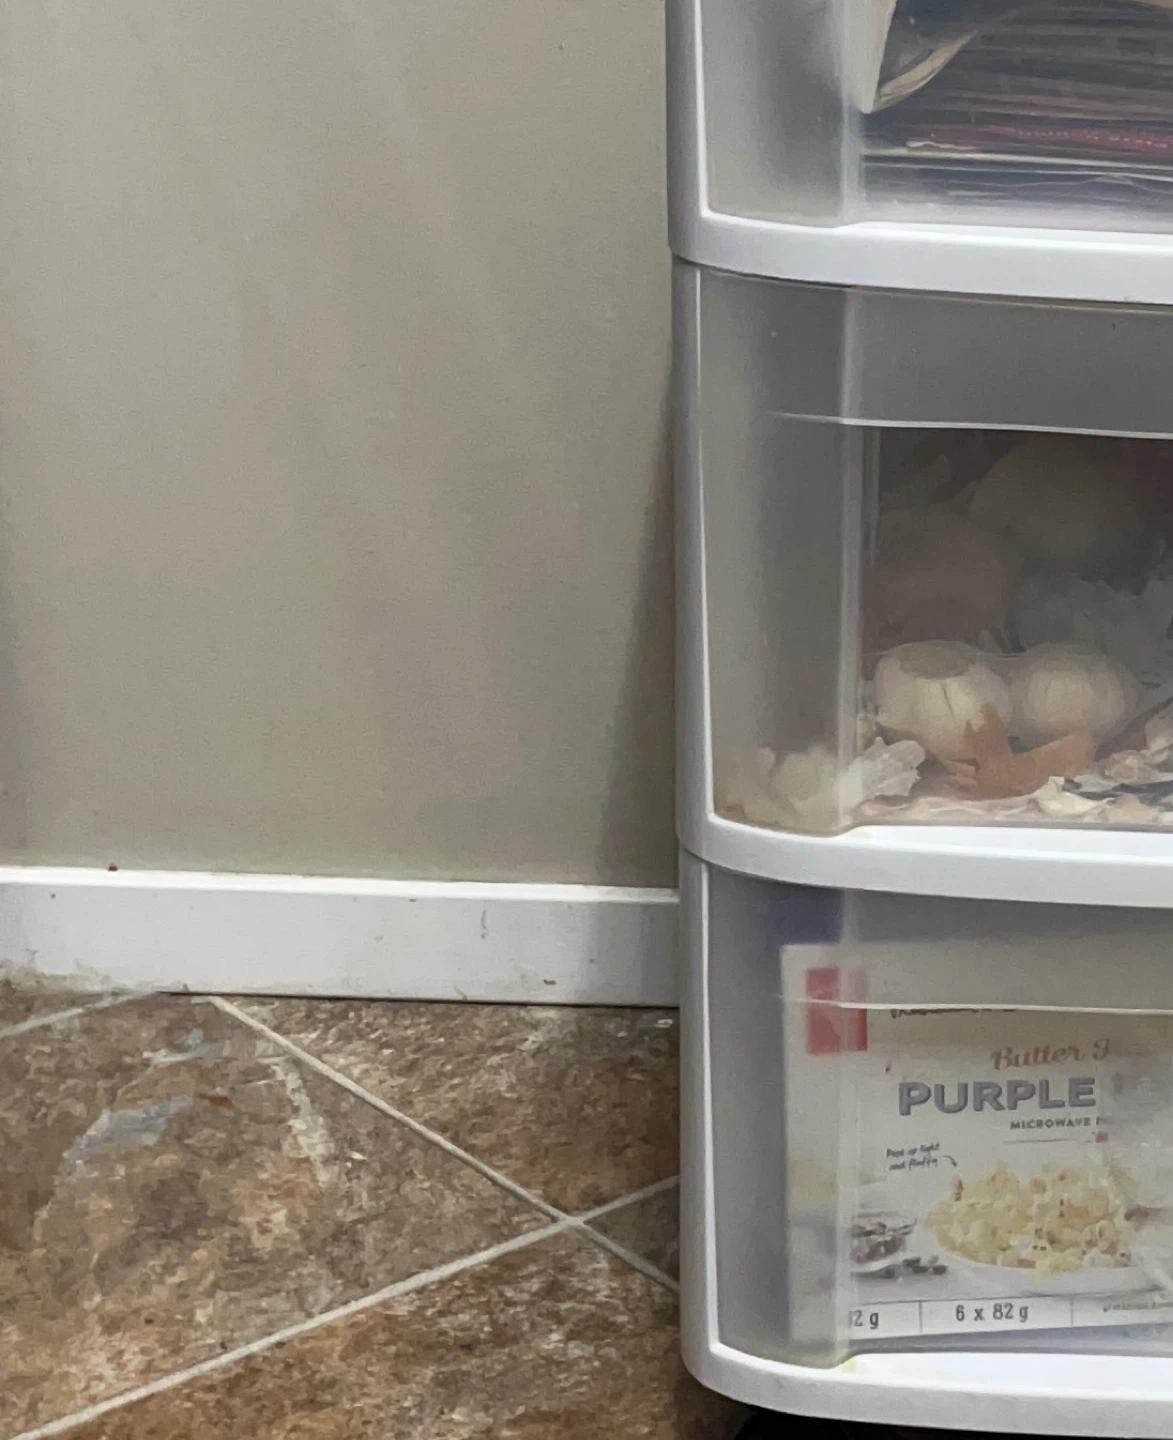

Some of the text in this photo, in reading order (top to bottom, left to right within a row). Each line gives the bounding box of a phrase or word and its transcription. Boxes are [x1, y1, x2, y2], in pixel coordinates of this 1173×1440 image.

[990, 1044, 1084, 1071] Butter
[898, 1077, 1097, 1117] PURPLE
[1009, 1117, 1091, 1130] MICROWAVE
[869, 1312, 880, 1329] g
[955, 1302, 1030, 1323] 6 x 82 g
